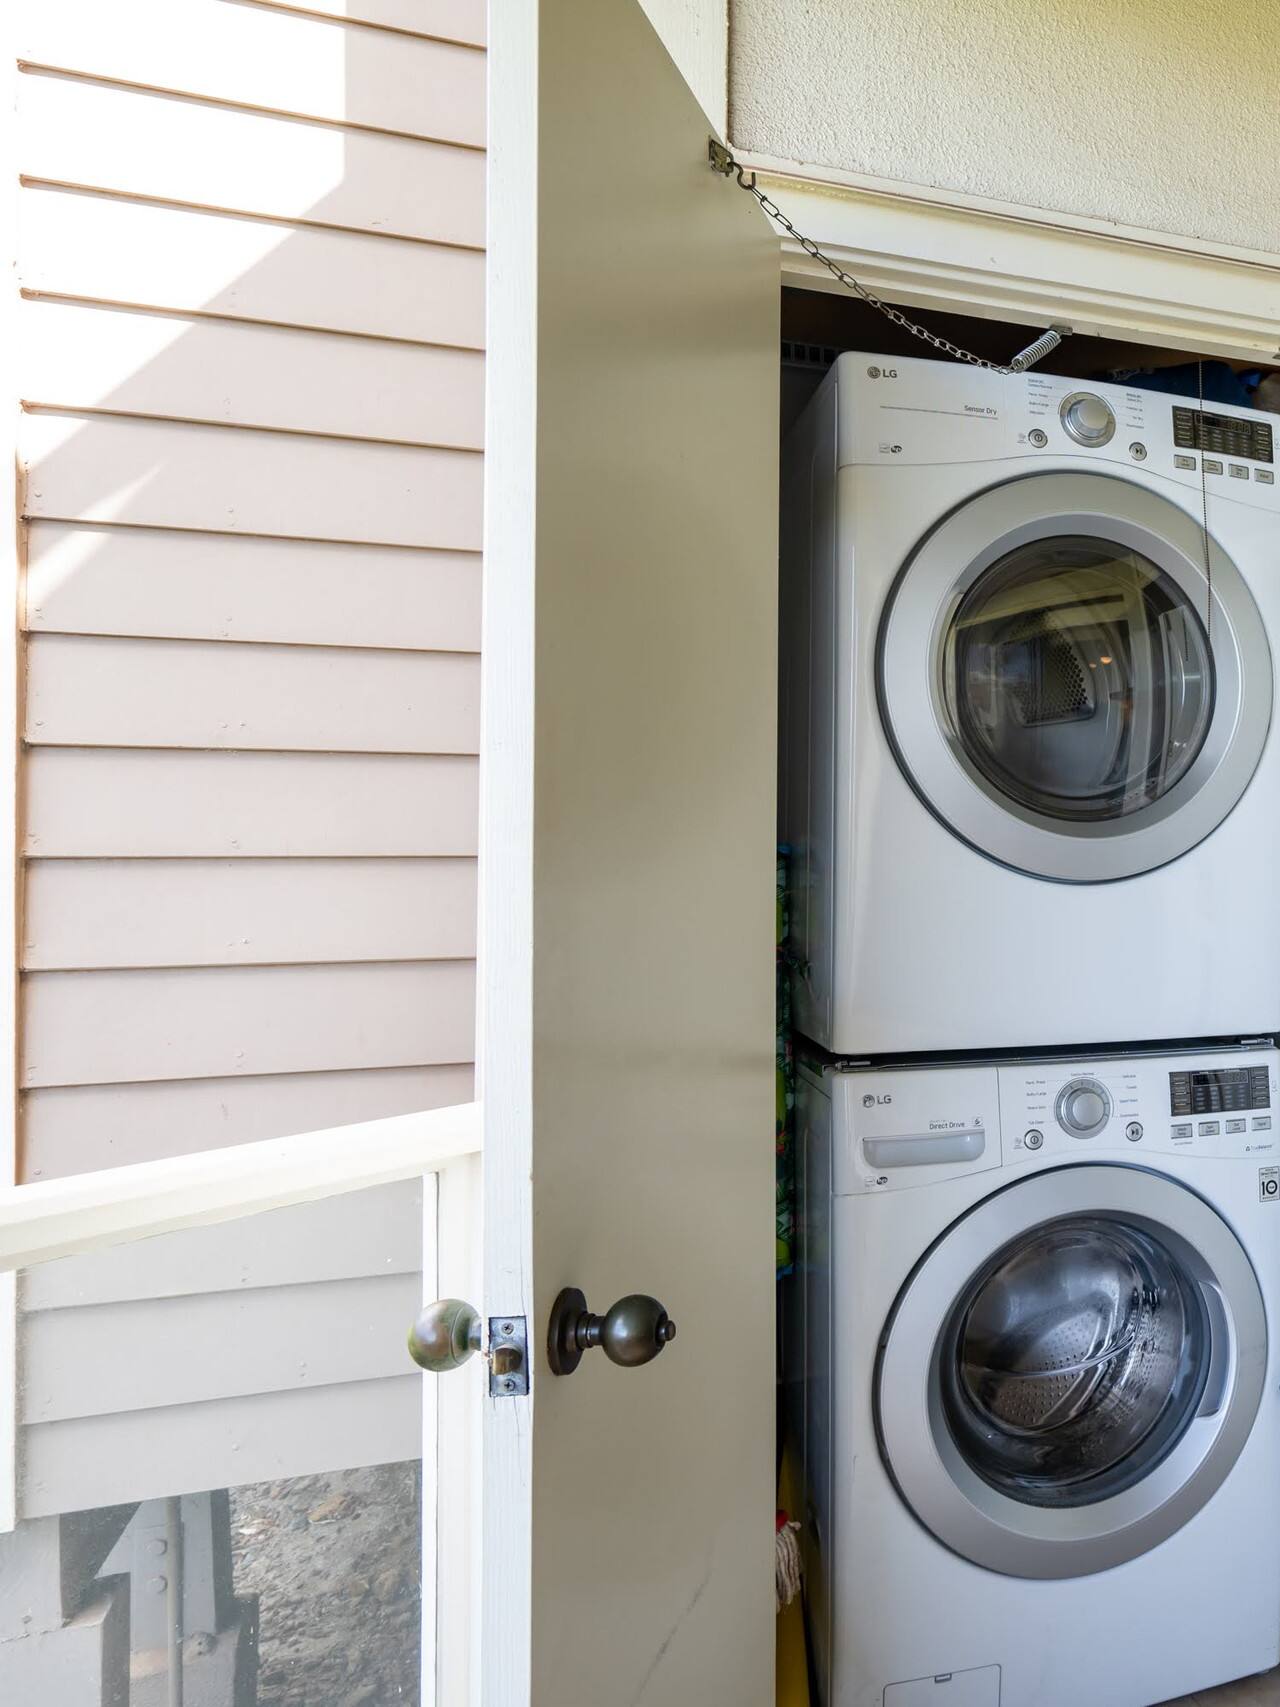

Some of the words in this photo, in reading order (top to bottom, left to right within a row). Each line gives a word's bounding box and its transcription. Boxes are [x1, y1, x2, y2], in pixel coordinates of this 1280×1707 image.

[882, 369, 898, 379] LG
[964, 404, 985, 414] Sensor
[986, 407, 997, 416] Dry
[876, 1094, 892, 1105] LG
[929, 1122, 949, 1130] Direct
[949, 1121, 966, 1129] Drive
[1262, 1179, 1278, 1196] 10
